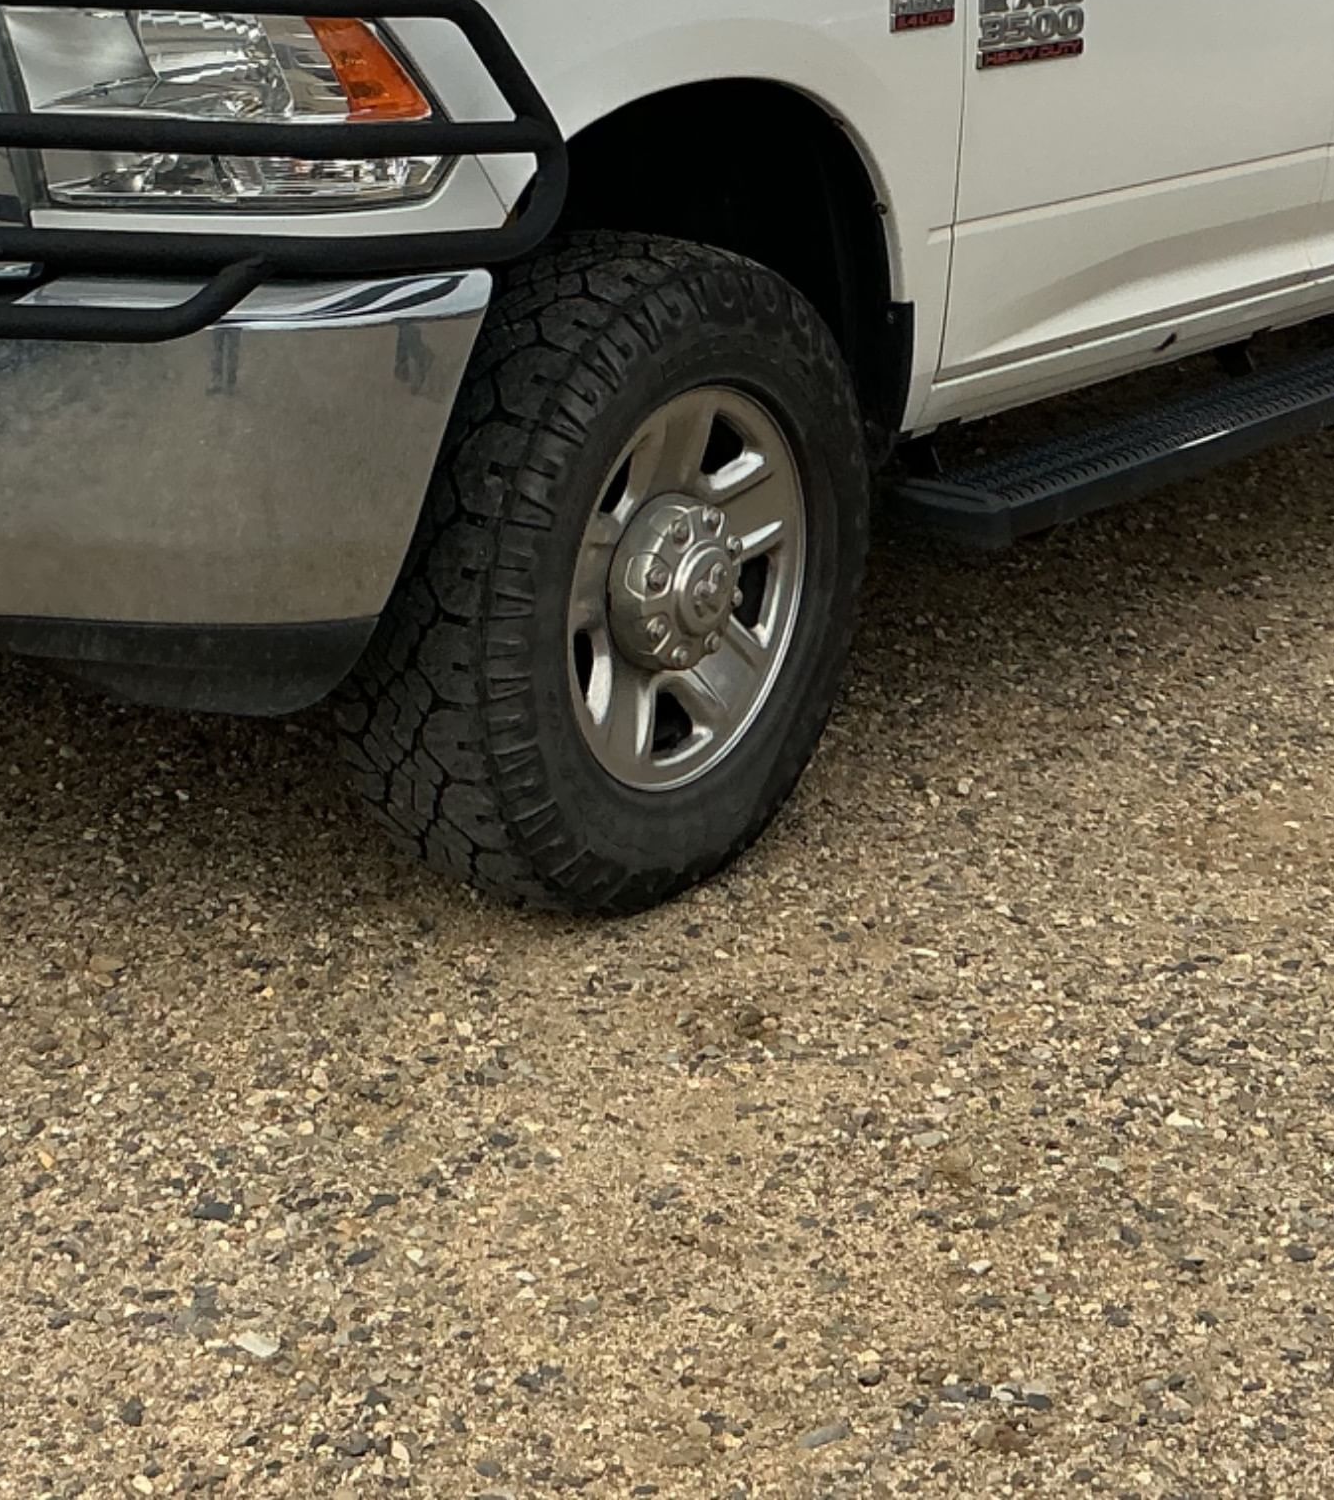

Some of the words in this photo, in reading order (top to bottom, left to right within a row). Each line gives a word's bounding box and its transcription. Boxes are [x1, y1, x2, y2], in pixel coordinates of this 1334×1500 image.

[978, 5, 1084, 48] 3500
[985, 47, 1037, 67] HEAVY
[1038, 42, 1081, 59] DUTY
